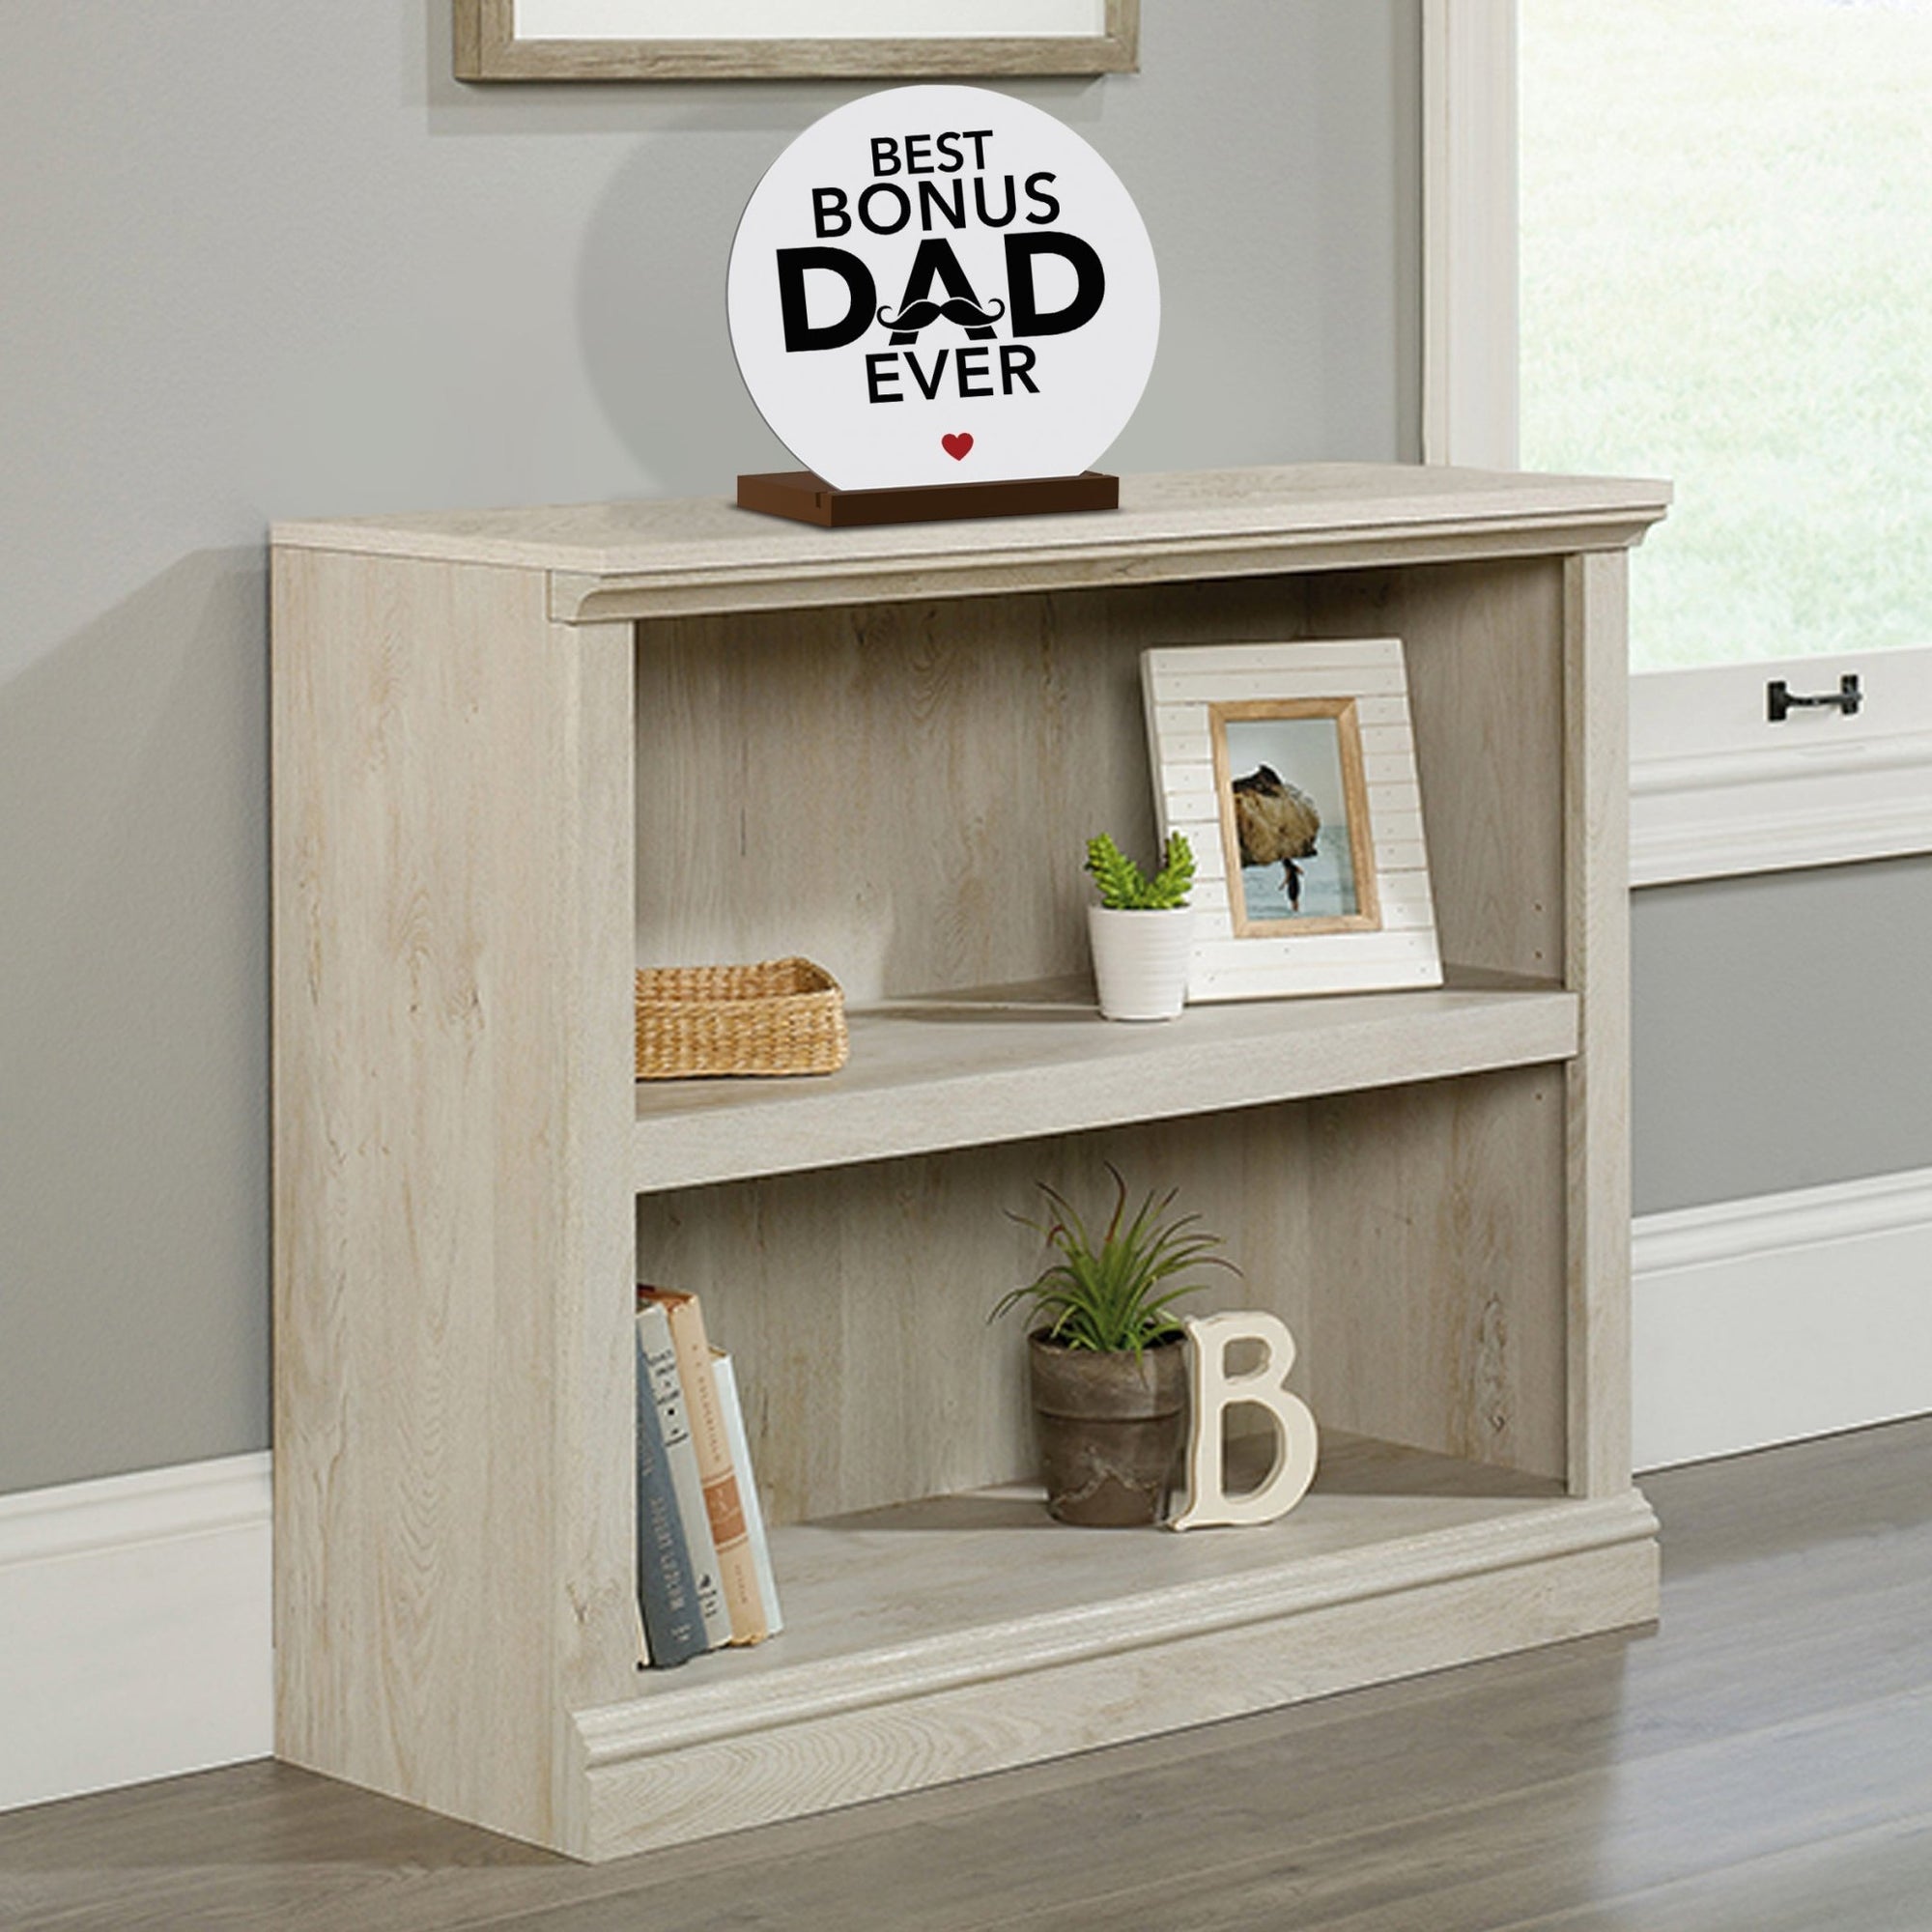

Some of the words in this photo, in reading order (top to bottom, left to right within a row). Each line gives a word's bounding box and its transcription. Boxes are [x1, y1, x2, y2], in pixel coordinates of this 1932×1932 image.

[870, 129, 994, 177] BEST
[812, 172, 1061, 238] BONUS
[777, 231, 1106, 353] DAD
[866, 345, 1040, 404] EVER
[1167, 1311, 1319, 1531] B
